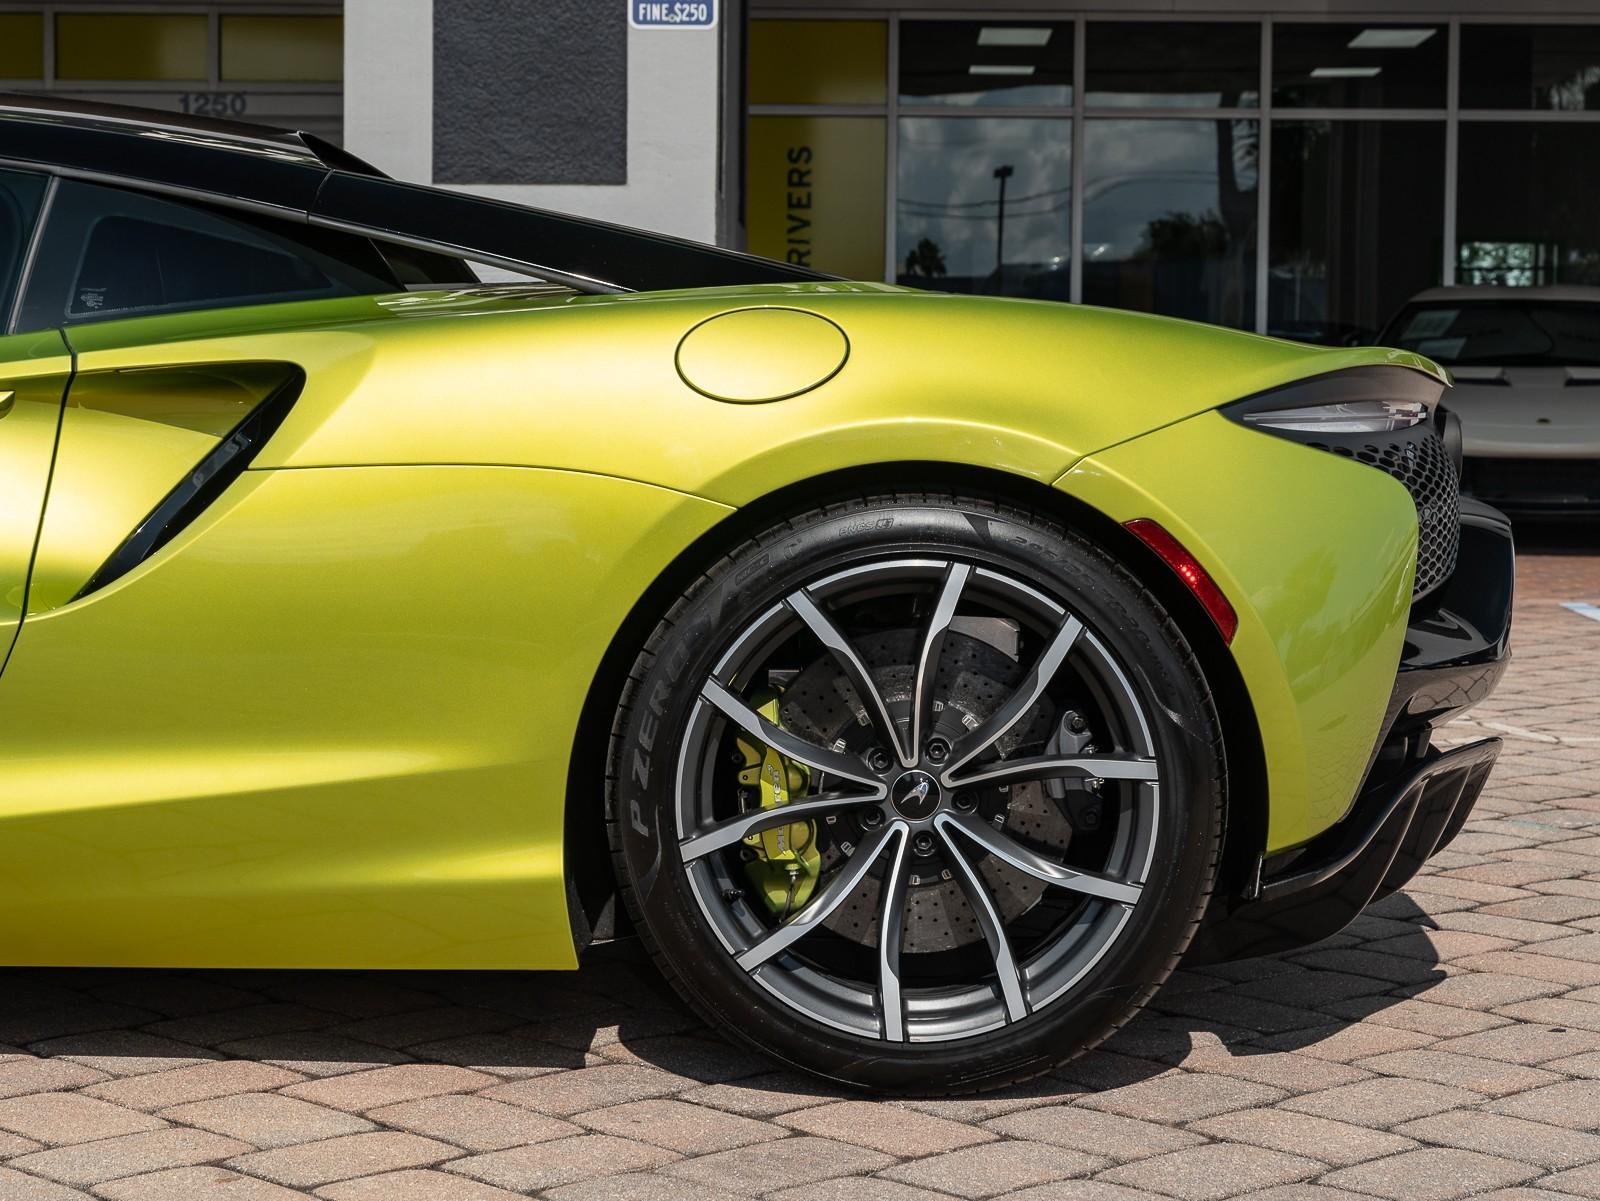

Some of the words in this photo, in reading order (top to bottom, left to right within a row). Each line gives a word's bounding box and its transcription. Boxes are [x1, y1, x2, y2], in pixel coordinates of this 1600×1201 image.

[638, 3, 669, 21] FINE
[674, 2, 707, 23] $250
[179, 93, 247, 116] 1250
[631, 640, 693, 791] ZERO
[630, 799, 649, 838] P
